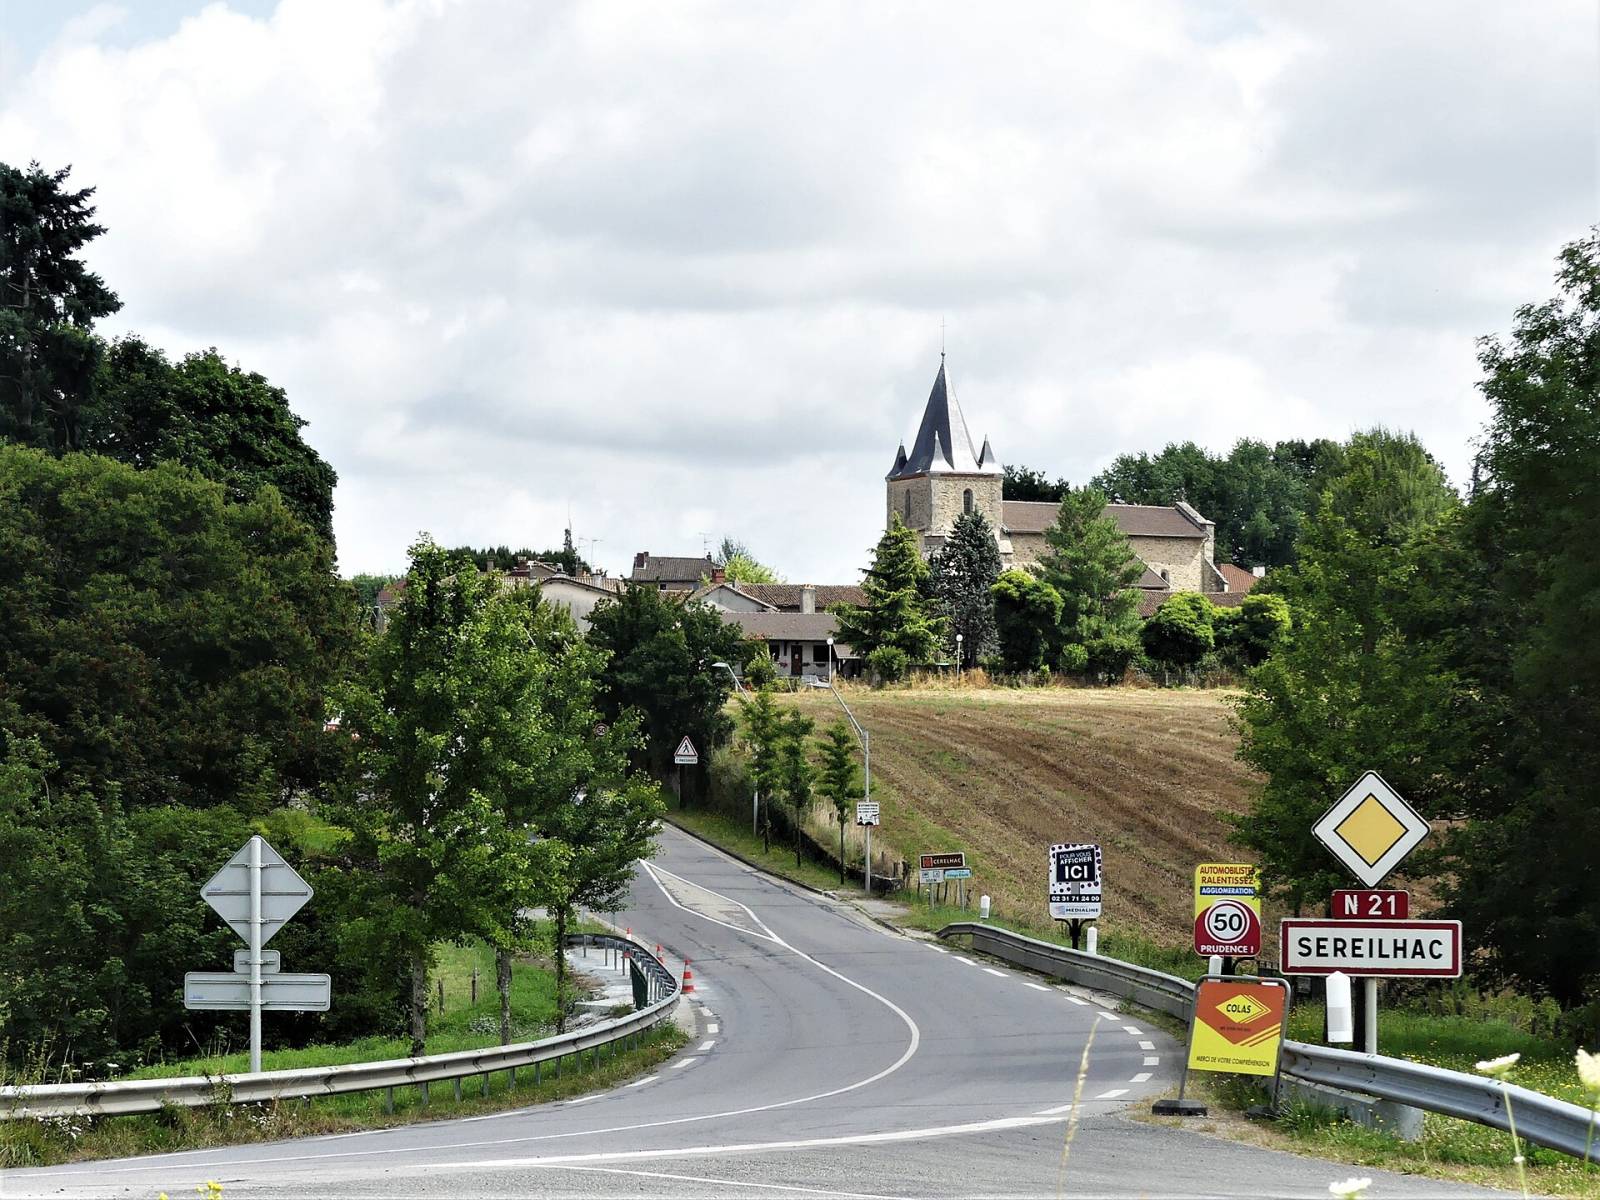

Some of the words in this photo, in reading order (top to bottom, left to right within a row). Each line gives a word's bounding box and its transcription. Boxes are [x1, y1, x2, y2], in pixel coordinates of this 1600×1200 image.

[933, 857, 961, 865] CERELHAC
[1060, 857, 1092, 865] AFFICHER
[1065, 865, 1088, 879] ICI
[1200, 866, 1255, 875] AUTOMOBILIST
[1201, 876, 1254, 884] RALENTISSEZ
[1344, 894, 1358, 915] N
[1368, 894, 1396, 915] 21
[1213, 913, 1243, 931] 50
[1200, 944, 1248, 953] PRUDENCE
[1298, 936, 1443, 960] SEREILHAC
[1226, 1003, 1251, 1014] COLAS
